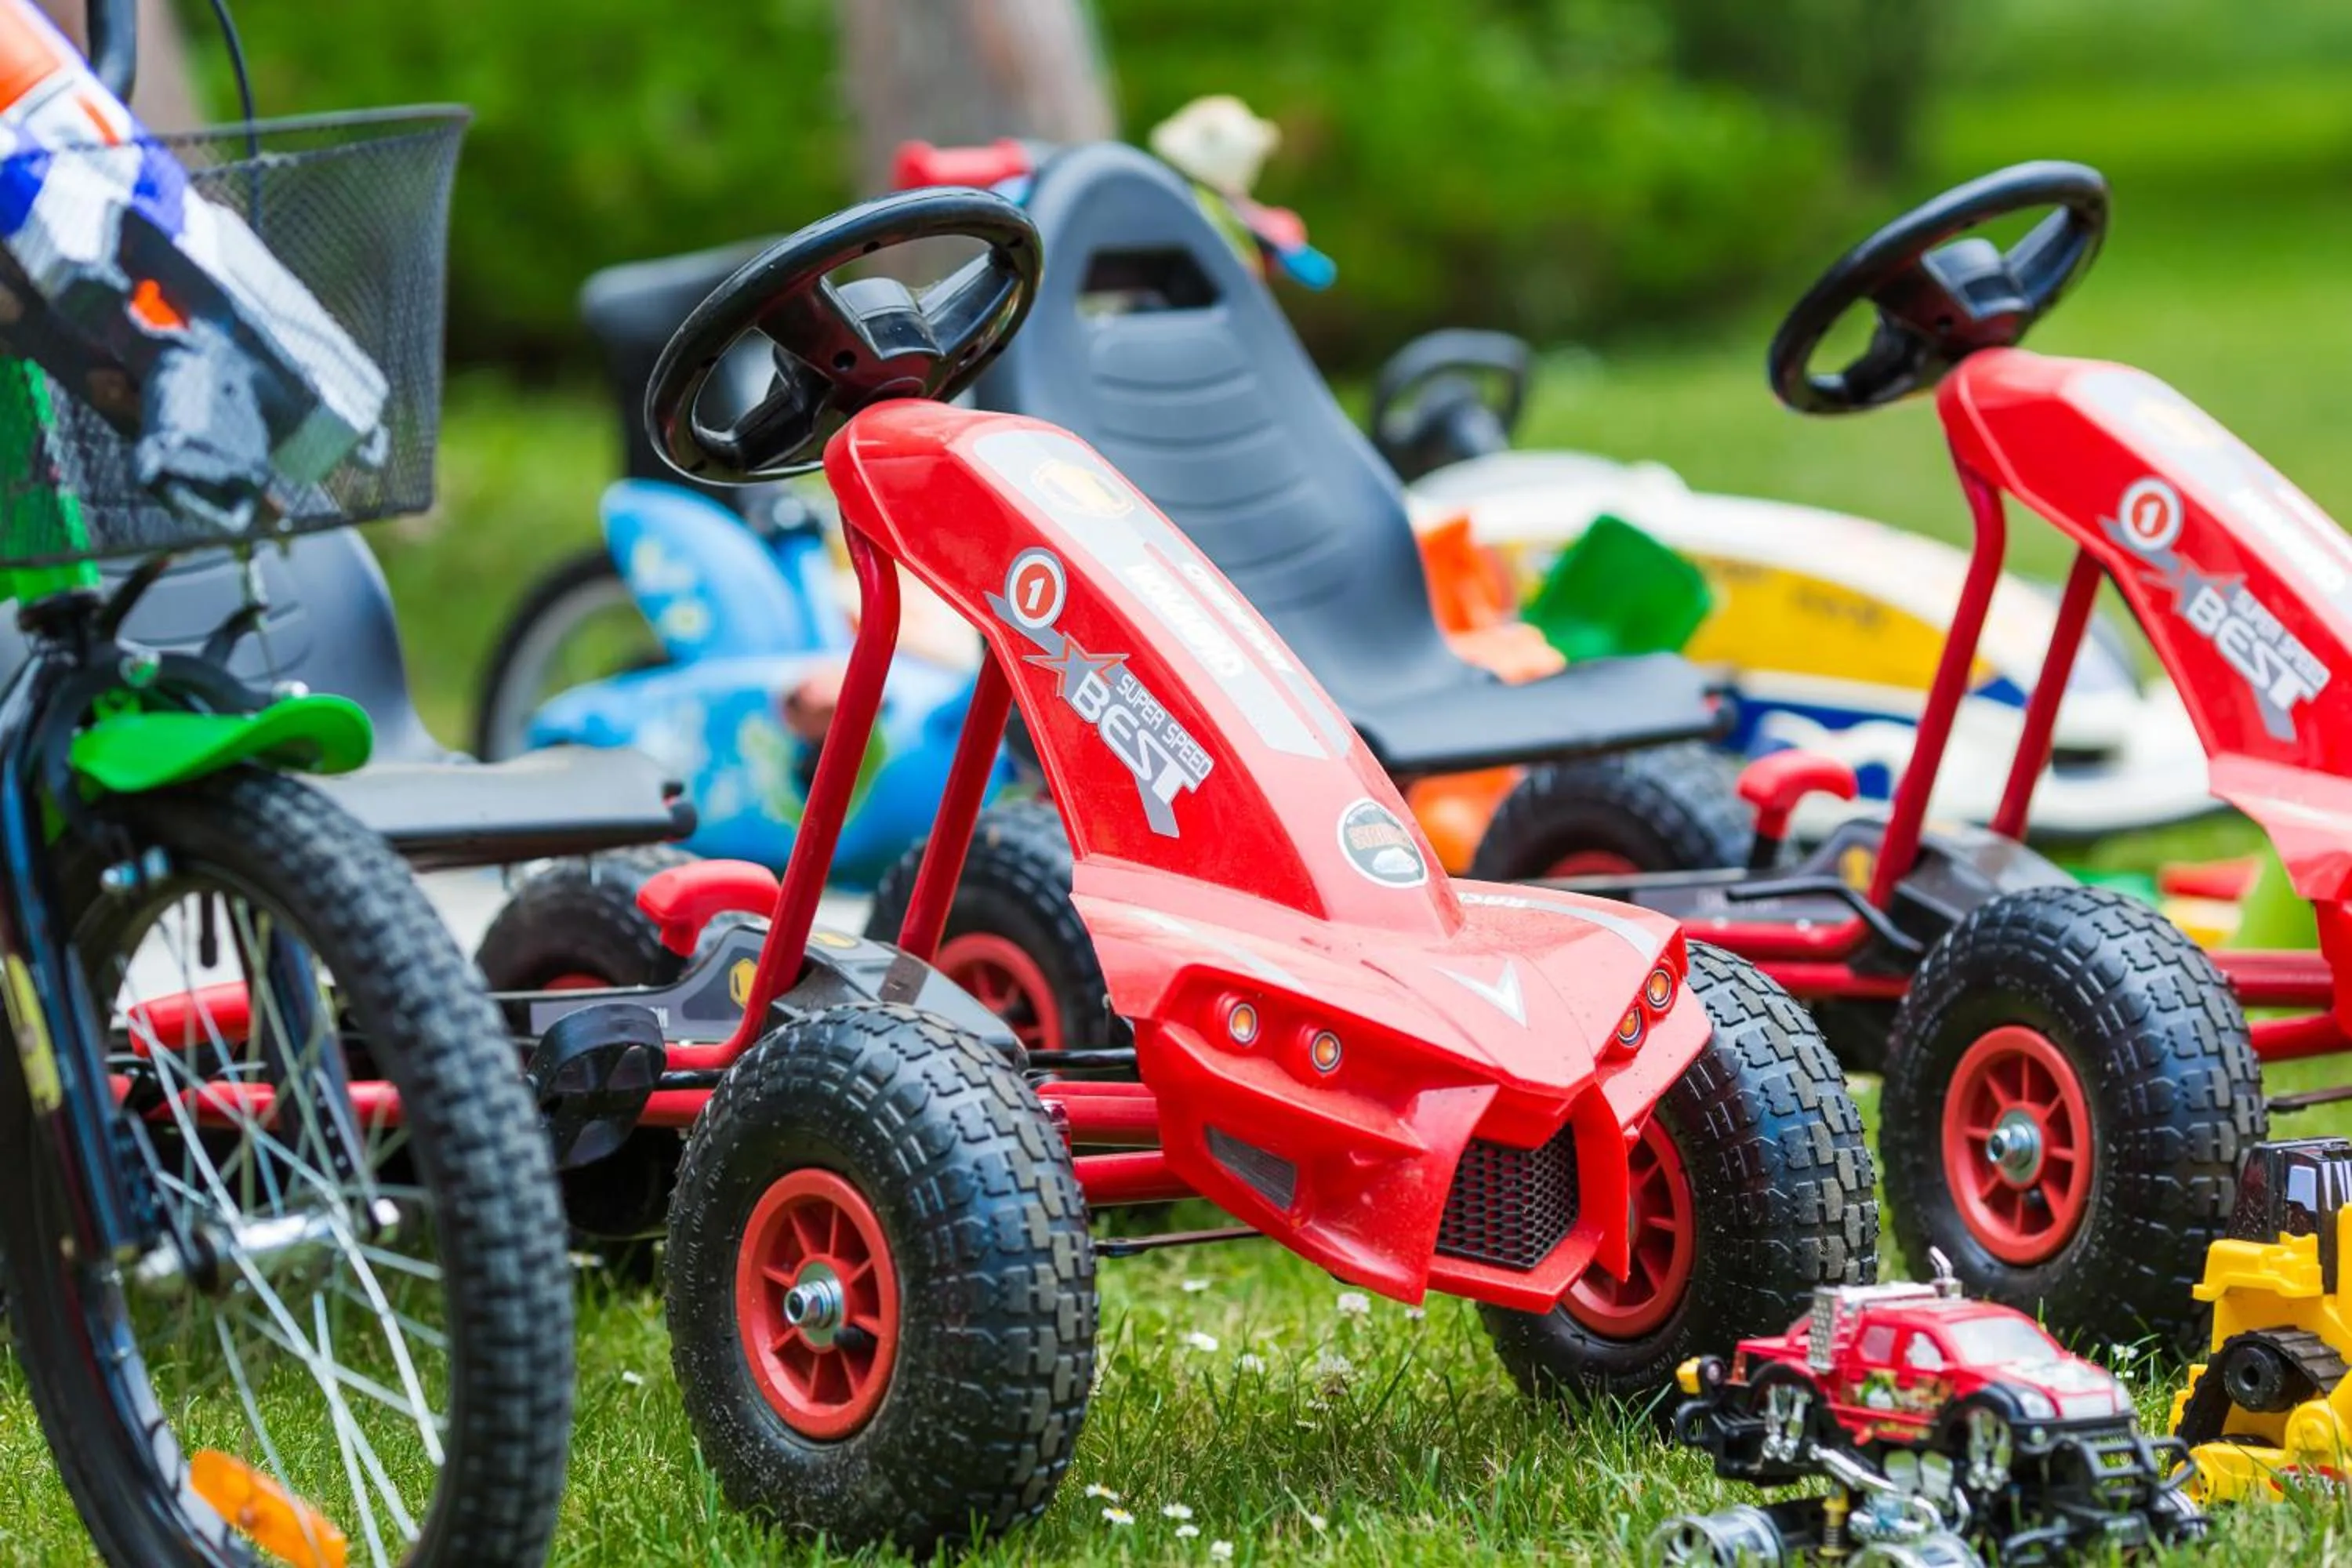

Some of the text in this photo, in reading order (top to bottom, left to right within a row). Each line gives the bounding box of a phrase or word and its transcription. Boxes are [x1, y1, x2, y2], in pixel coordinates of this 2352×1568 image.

[1025, 576, 1044, 611] 1
[2186, 585, 2316, 710] BEST
[1071, 669, 1200, 805] BEST
[1116, 673, 1167, 731] SUPER
[1162, 723, 1214, 782] SPEED
